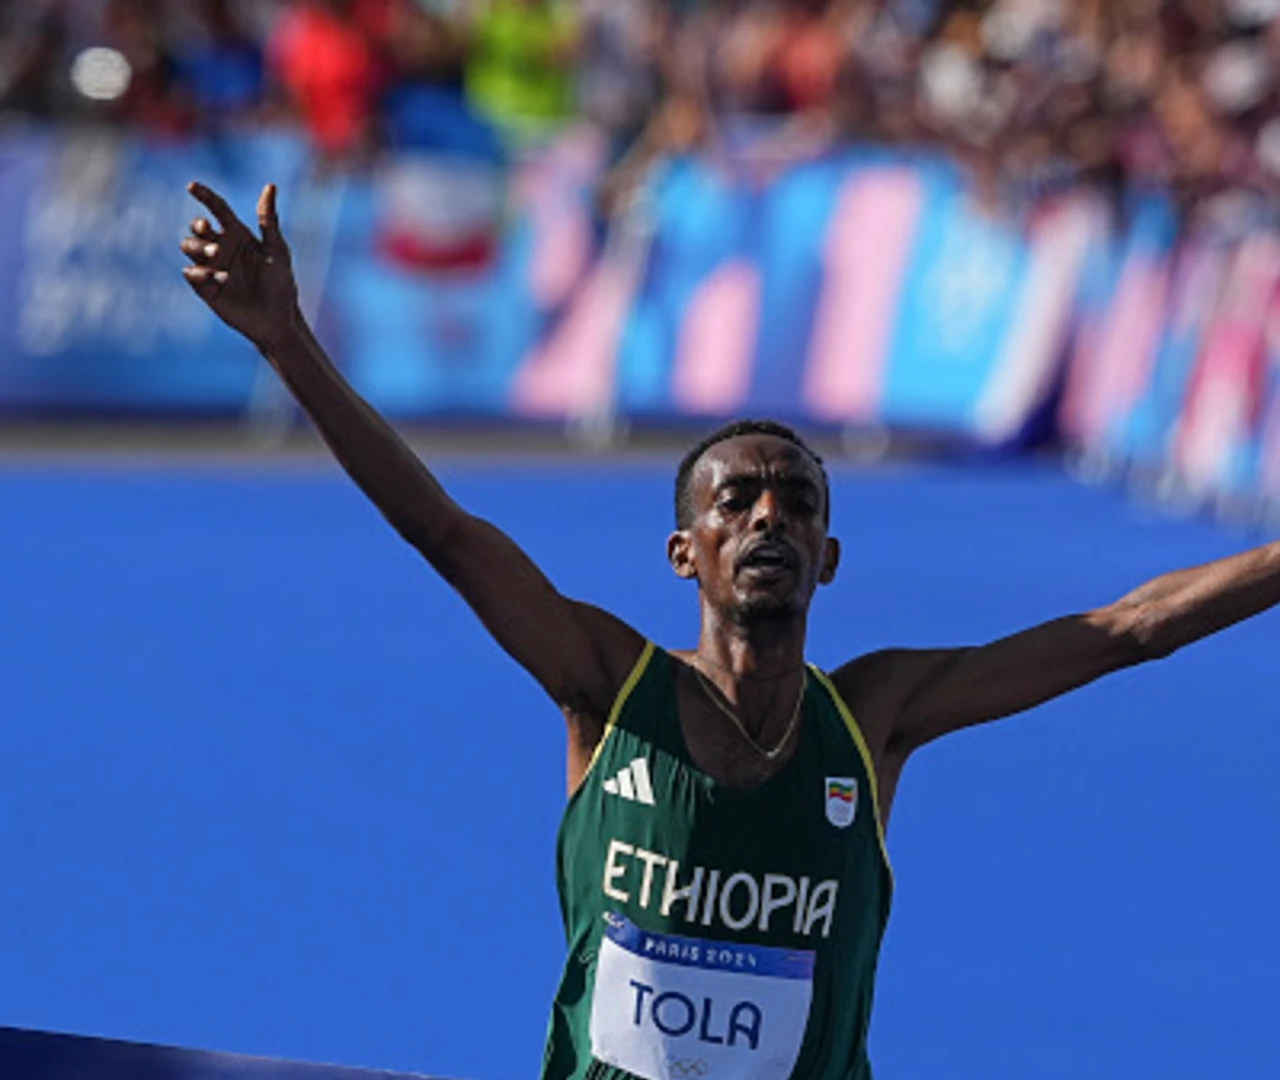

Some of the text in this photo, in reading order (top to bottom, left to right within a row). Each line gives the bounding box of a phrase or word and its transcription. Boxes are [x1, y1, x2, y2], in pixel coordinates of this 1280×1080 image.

[603, 839, 839, 938] ETHIOPIA
[705, 948, 757, 968] 2024
[629, 979, 763, 1051] TOLA
